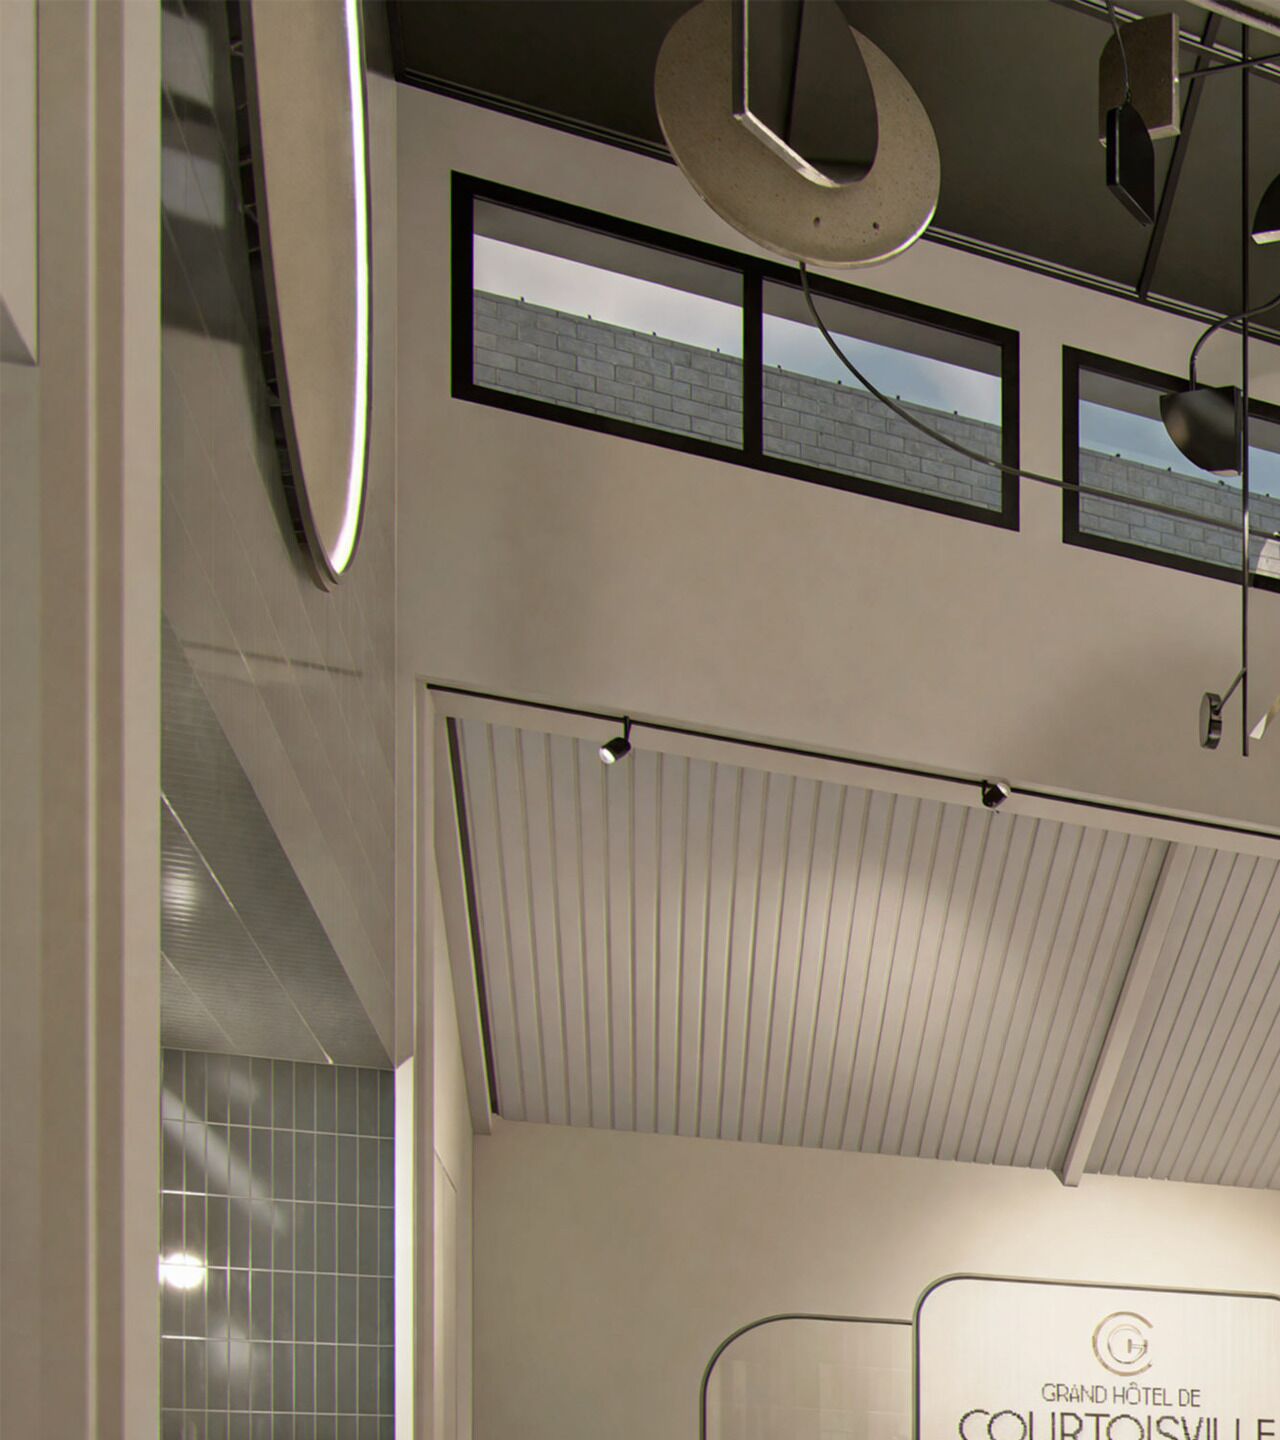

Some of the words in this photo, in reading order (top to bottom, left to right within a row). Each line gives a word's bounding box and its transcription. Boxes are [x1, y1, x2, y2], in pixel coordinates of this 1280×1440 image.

[1041, 1382, 1108, 1404] GRAND
[1112, 1381, 1173, 1408] HÔTEL
[1178, 1388, 1201, 1408] DE
